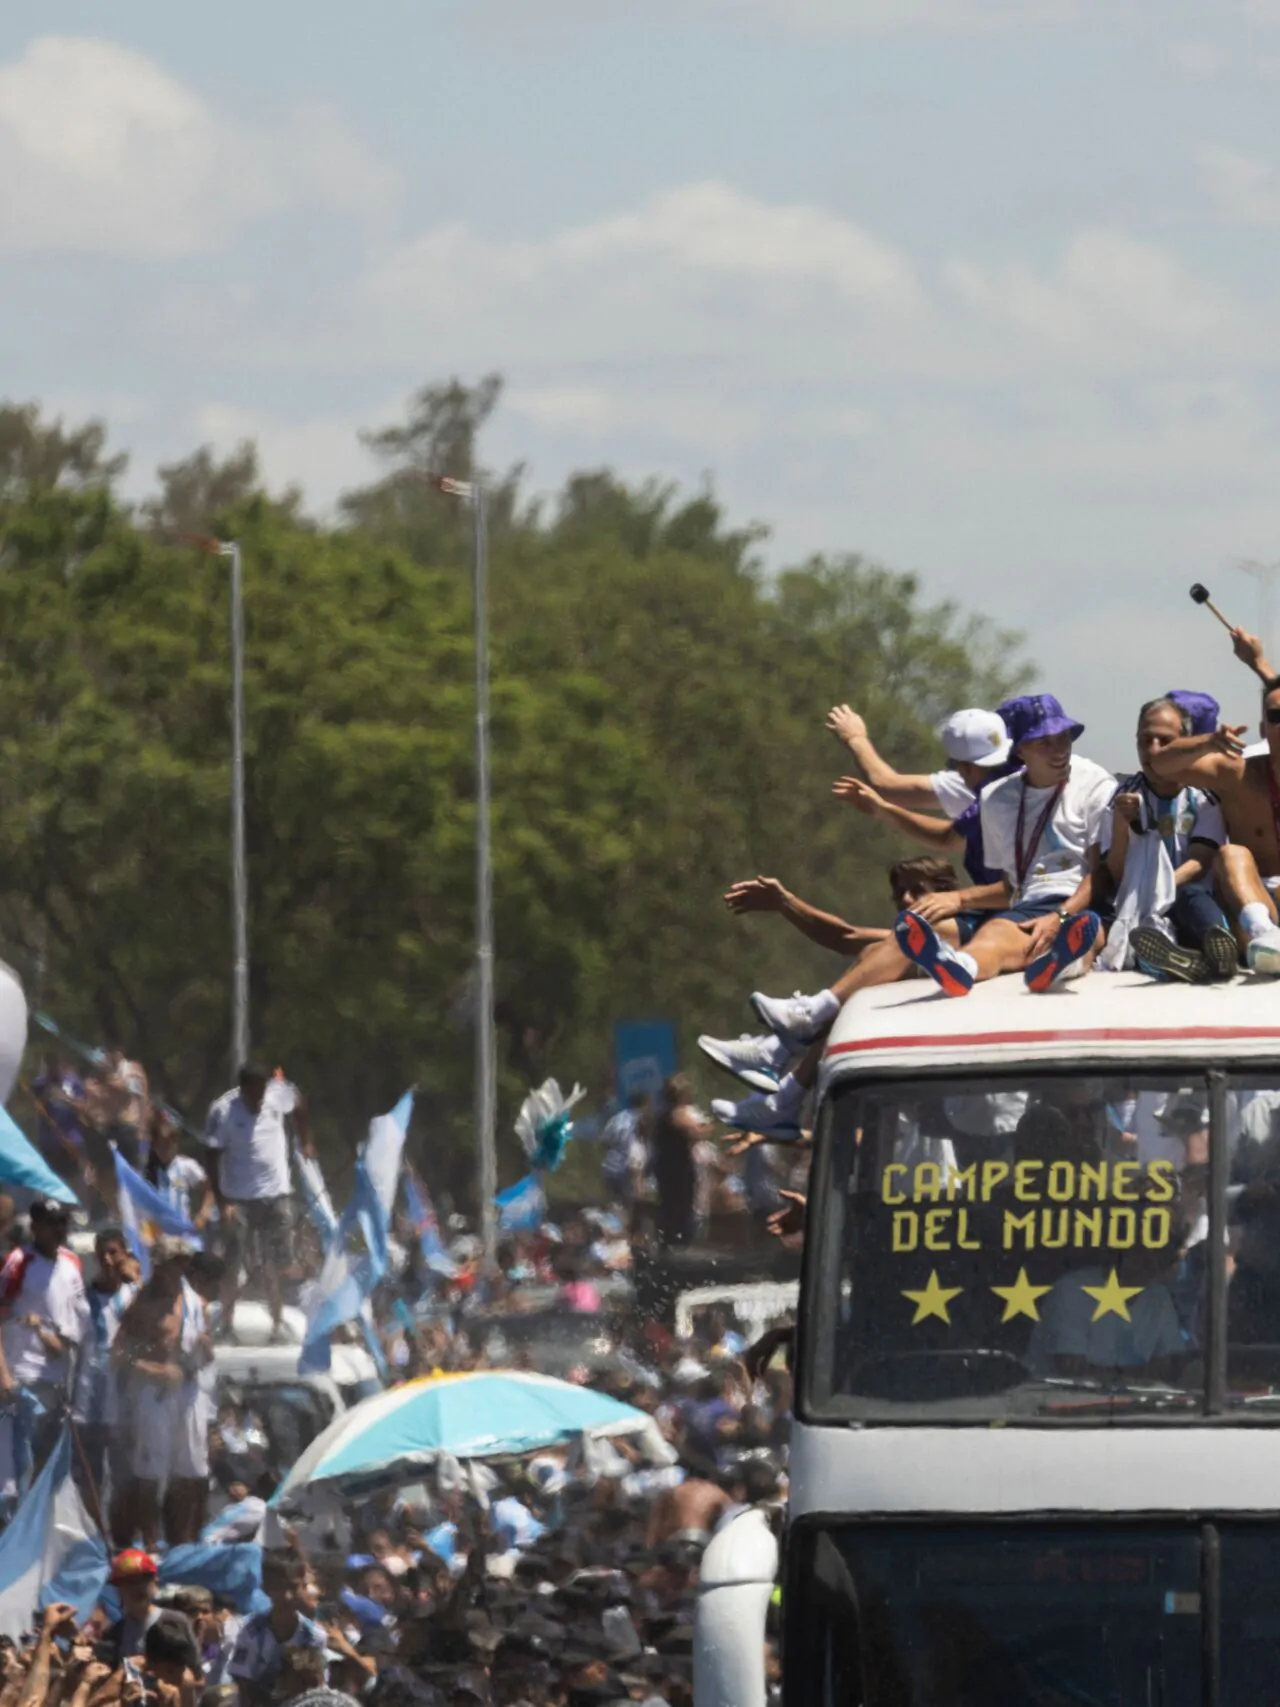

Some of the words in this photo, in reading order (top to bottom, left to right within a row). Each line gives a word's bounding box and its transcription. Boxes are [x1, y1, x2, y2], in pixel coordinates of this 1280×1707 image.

[881, 1160, 1175, 1204] CAMPEONES
[892, 1208, 981, 1251] DEL
[1003, 1207, 1171, 1249] MUNDO
